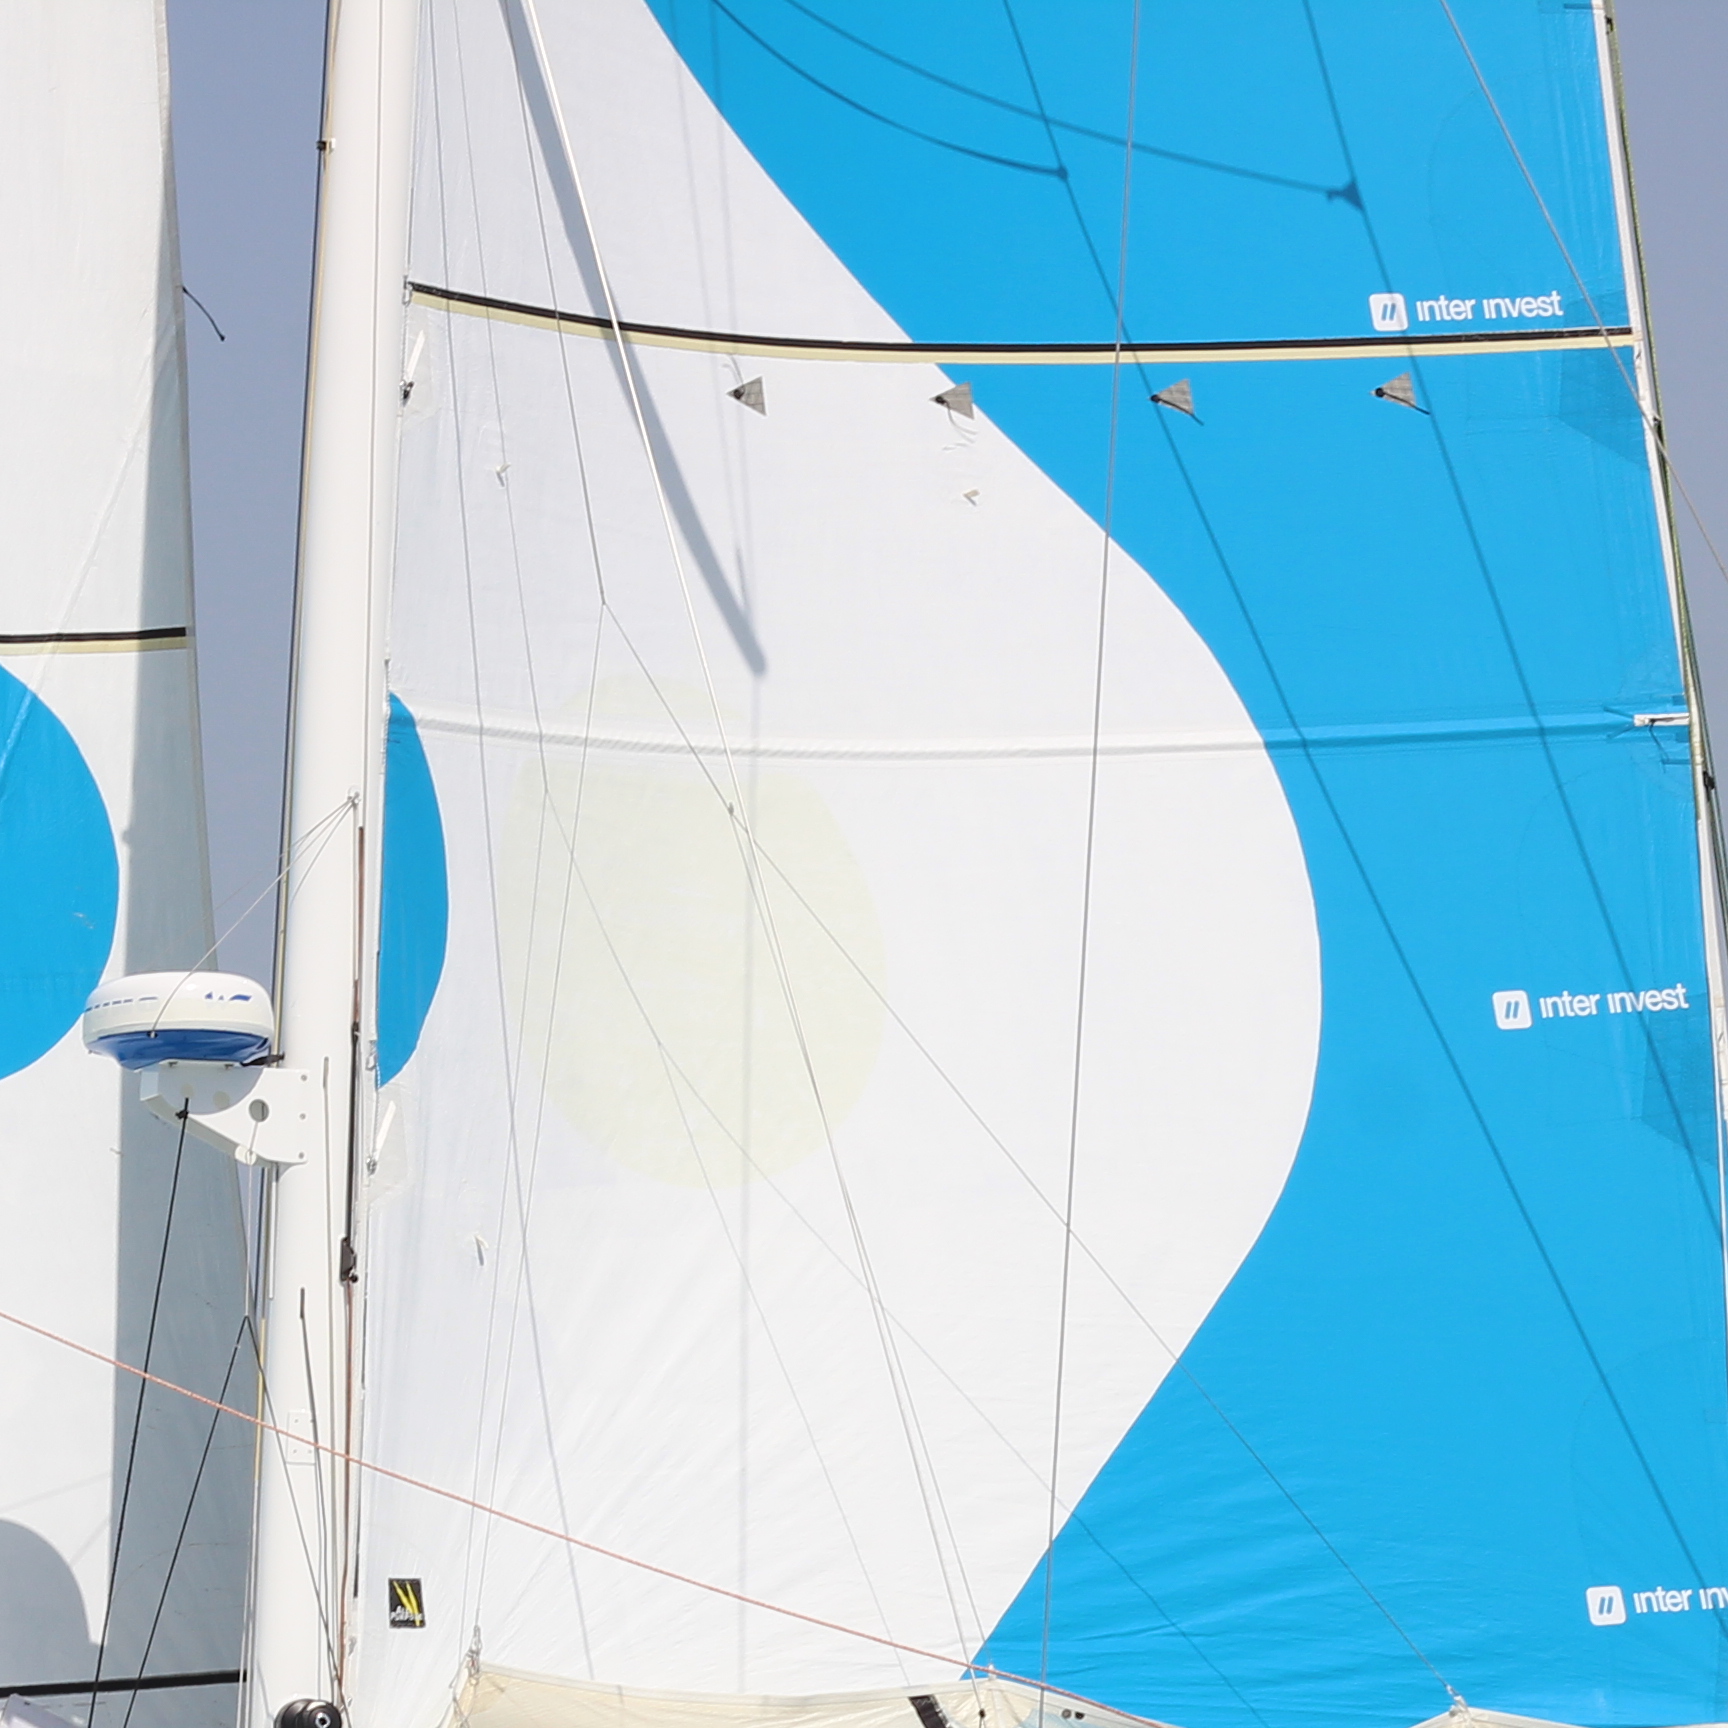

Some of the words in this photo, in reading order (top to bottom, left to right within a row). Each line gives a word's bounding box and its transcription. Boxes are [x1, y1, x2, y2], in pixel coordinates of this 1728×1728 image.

[1416, 295, 1476, 321] inter
[1483, 290, 1564, 319] invest
[1539, 990, 1600, 1019] inter
[1607, 983, 1690, 1014] invest
[1633, 1586, 1693, 1614] inter
